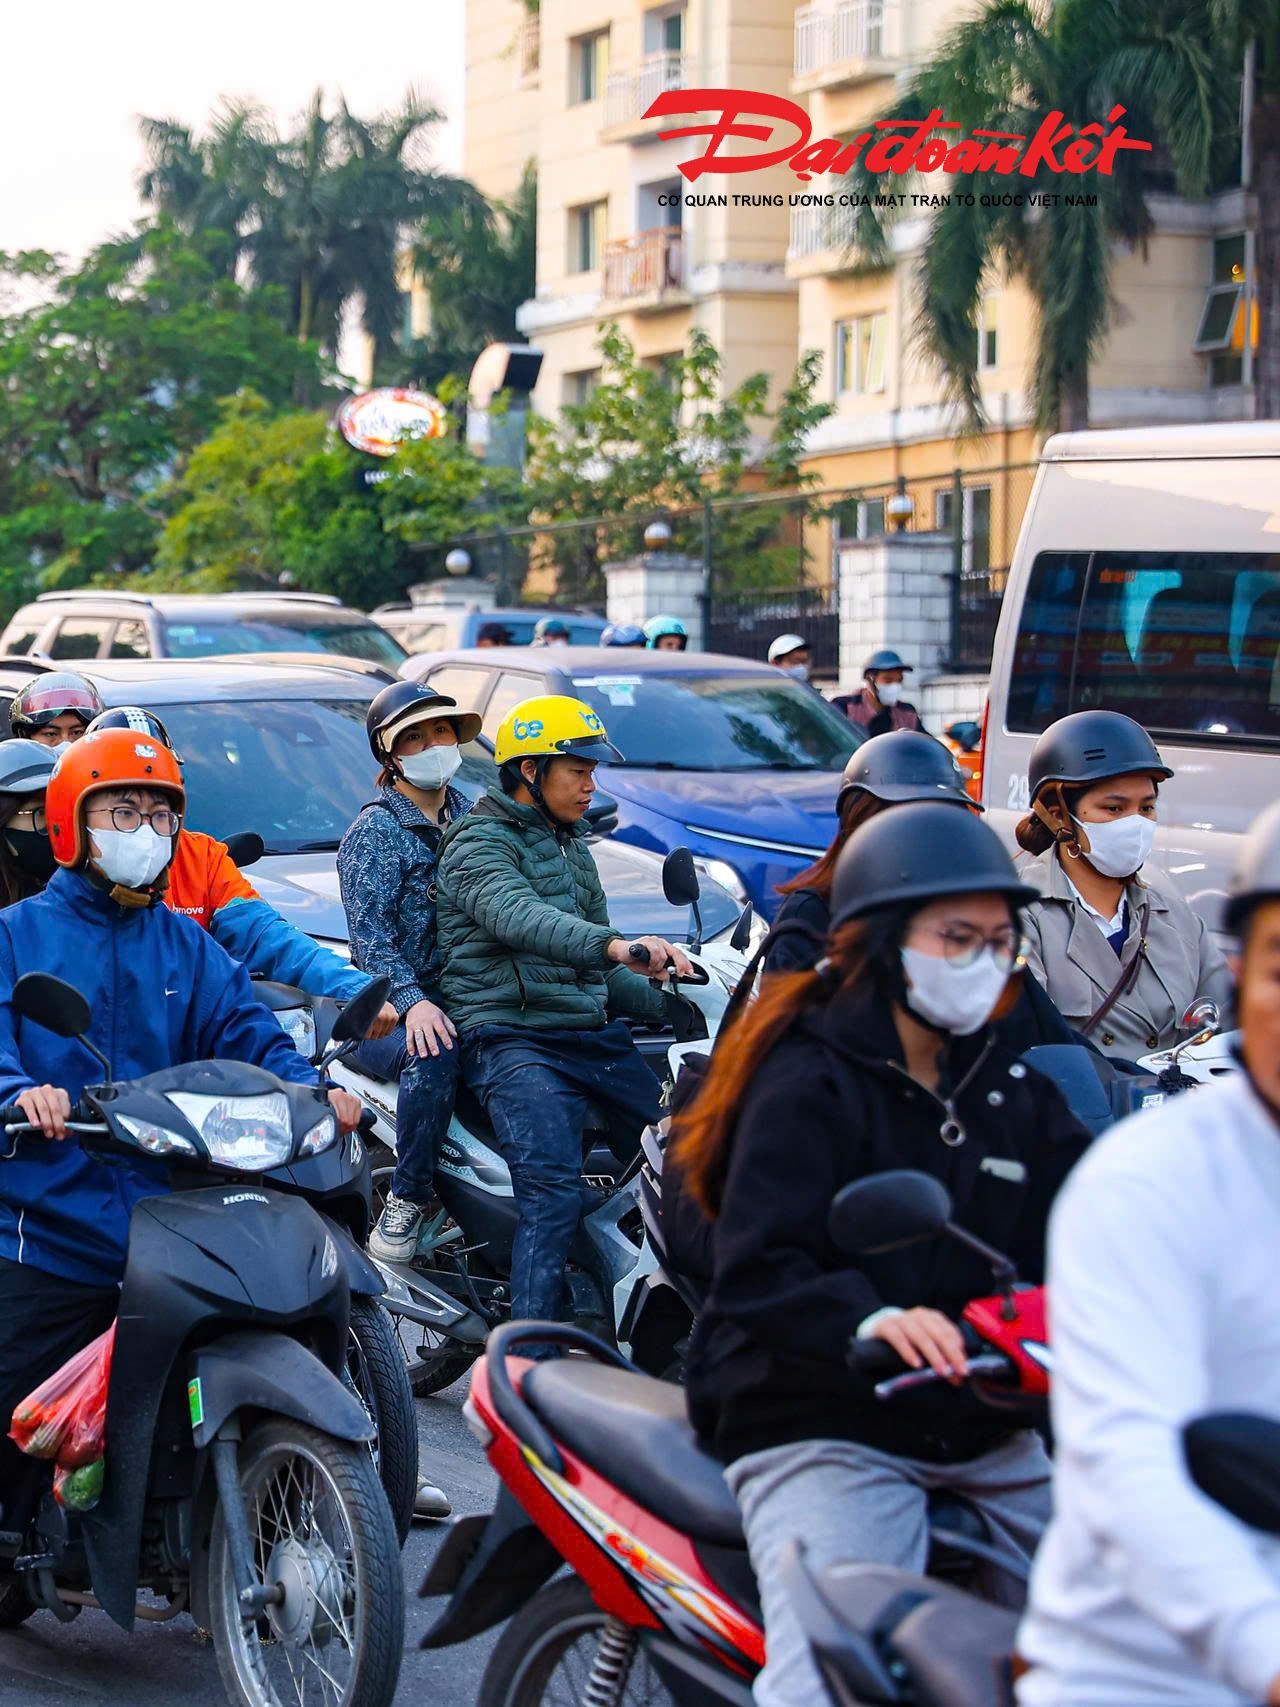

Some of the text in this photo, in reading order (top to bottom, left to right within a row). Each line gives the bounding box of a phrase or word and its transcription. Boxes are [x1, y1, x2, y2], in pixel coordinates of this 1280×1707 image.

[514, 718, 544, 741] be
[578, 712, 602, 731] b
[223, 1193, 269, 1205] HONDA
